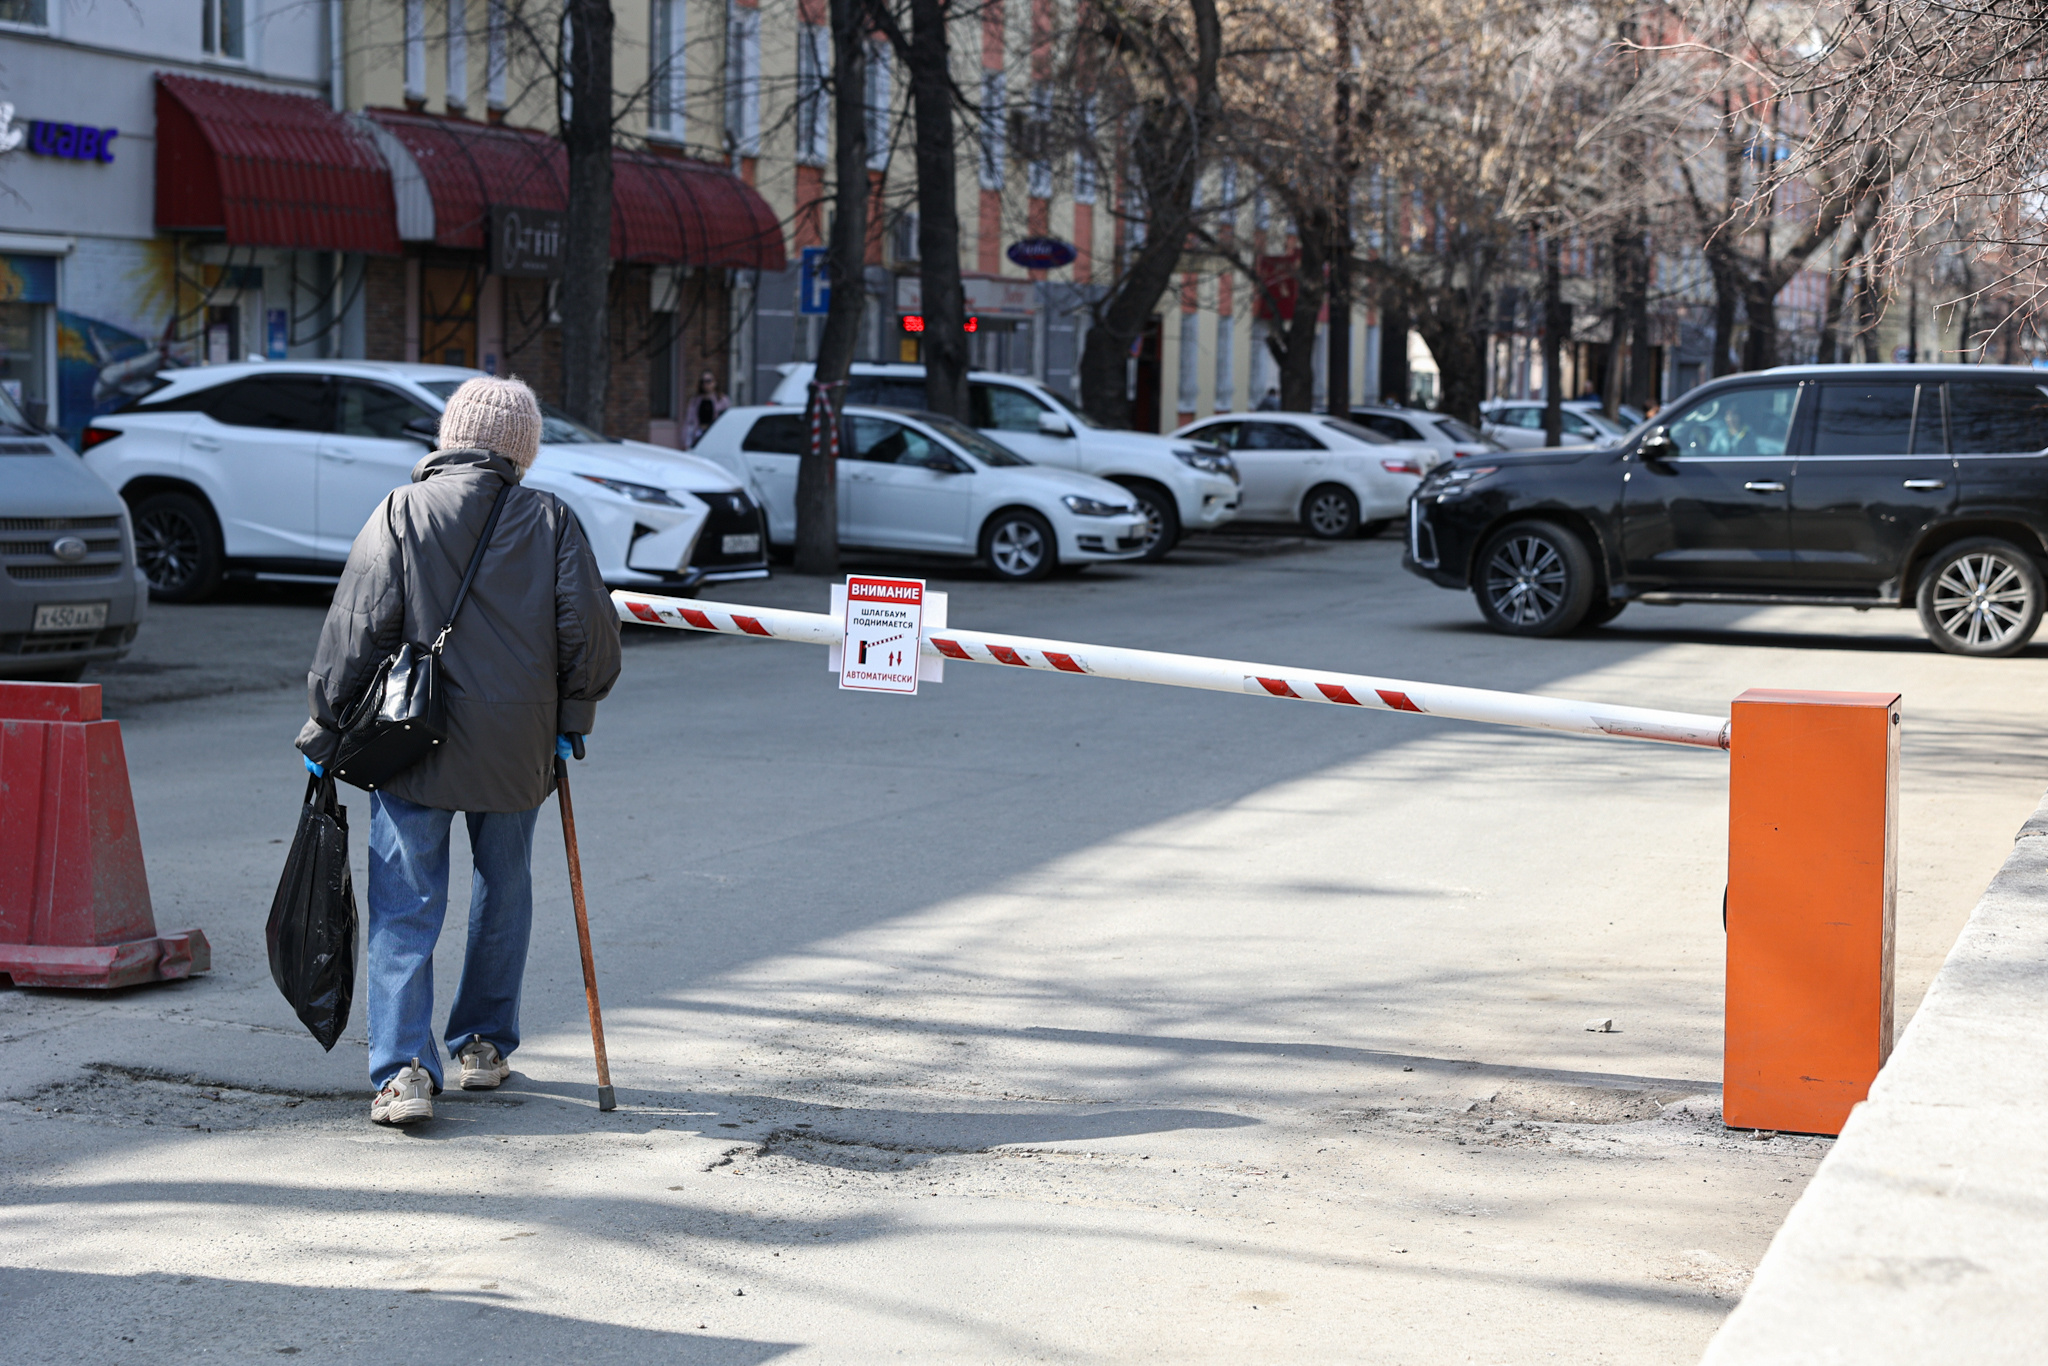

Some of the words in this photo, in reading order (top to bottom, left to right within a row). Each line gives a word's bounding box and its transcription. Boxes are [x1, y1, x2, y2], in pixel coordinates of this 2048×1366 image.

[851, 583, 920, 600] ВНИМАНИЕ
[861, 608, 907, 619] ШЛАГБАУМ
[853, 618, 913, 629] ПОДНИМАЕТСЯ
[846, 670, 912, 683] АВТОМАТИЧЕСКИ
